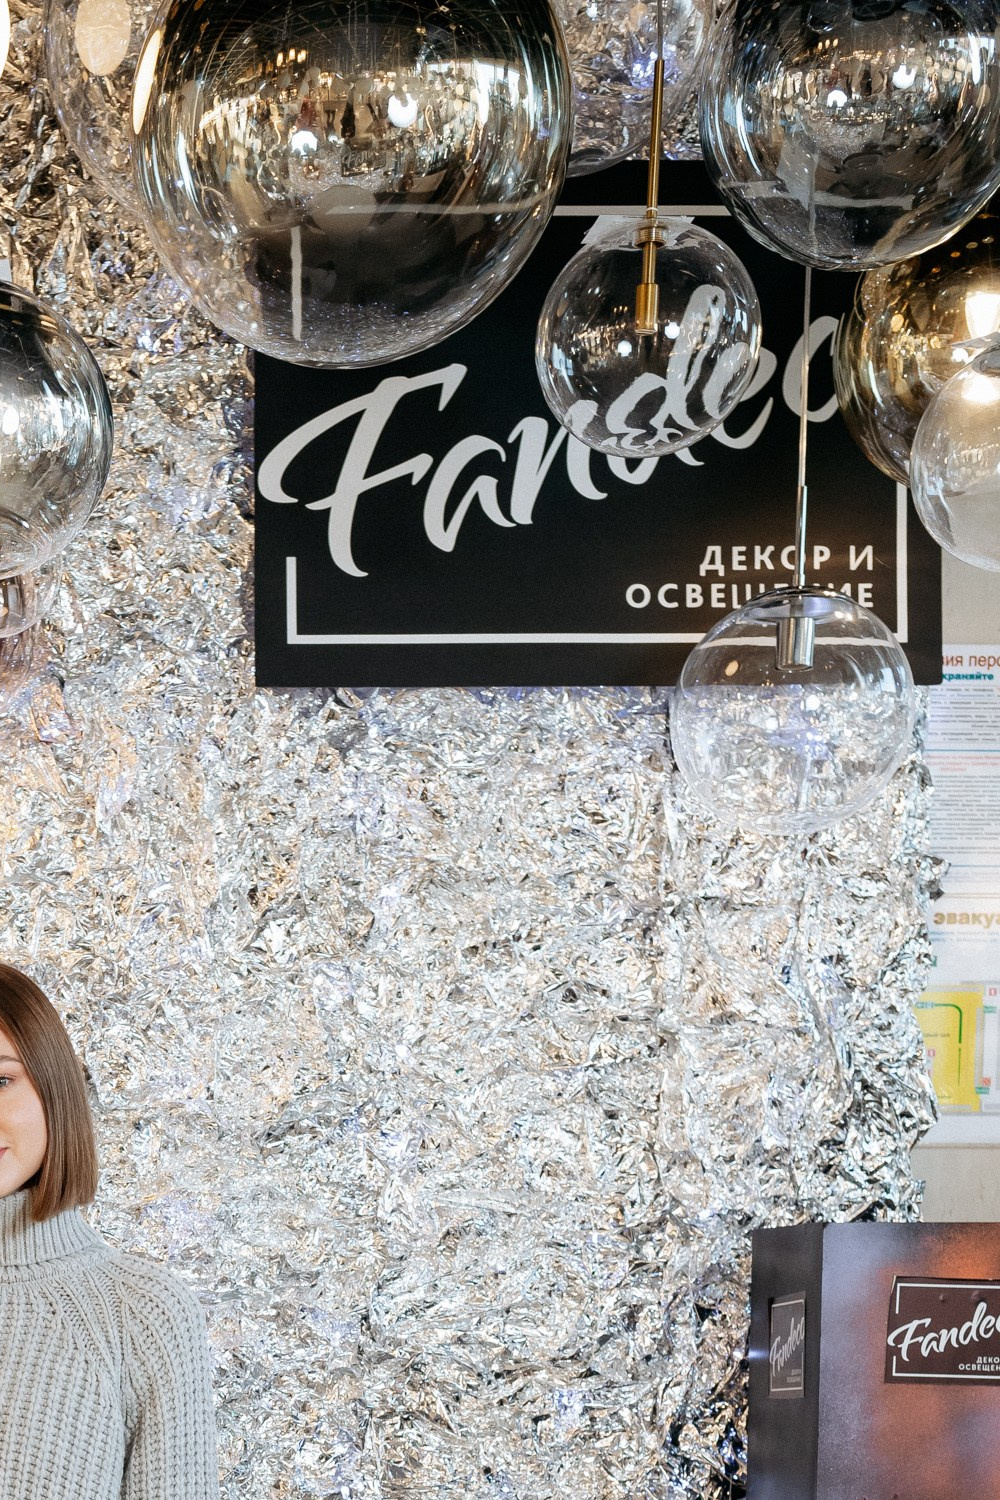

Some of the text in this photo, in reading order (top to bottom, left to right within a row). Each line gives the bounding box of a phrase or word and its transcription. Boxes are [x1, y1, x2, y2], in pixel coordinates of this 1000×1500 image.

[699, 545, 874, 577] ДЕКОР И
[625, 583, 874, 609] ОСВЕЩЕ
[942, 655, 963, 667] ия
